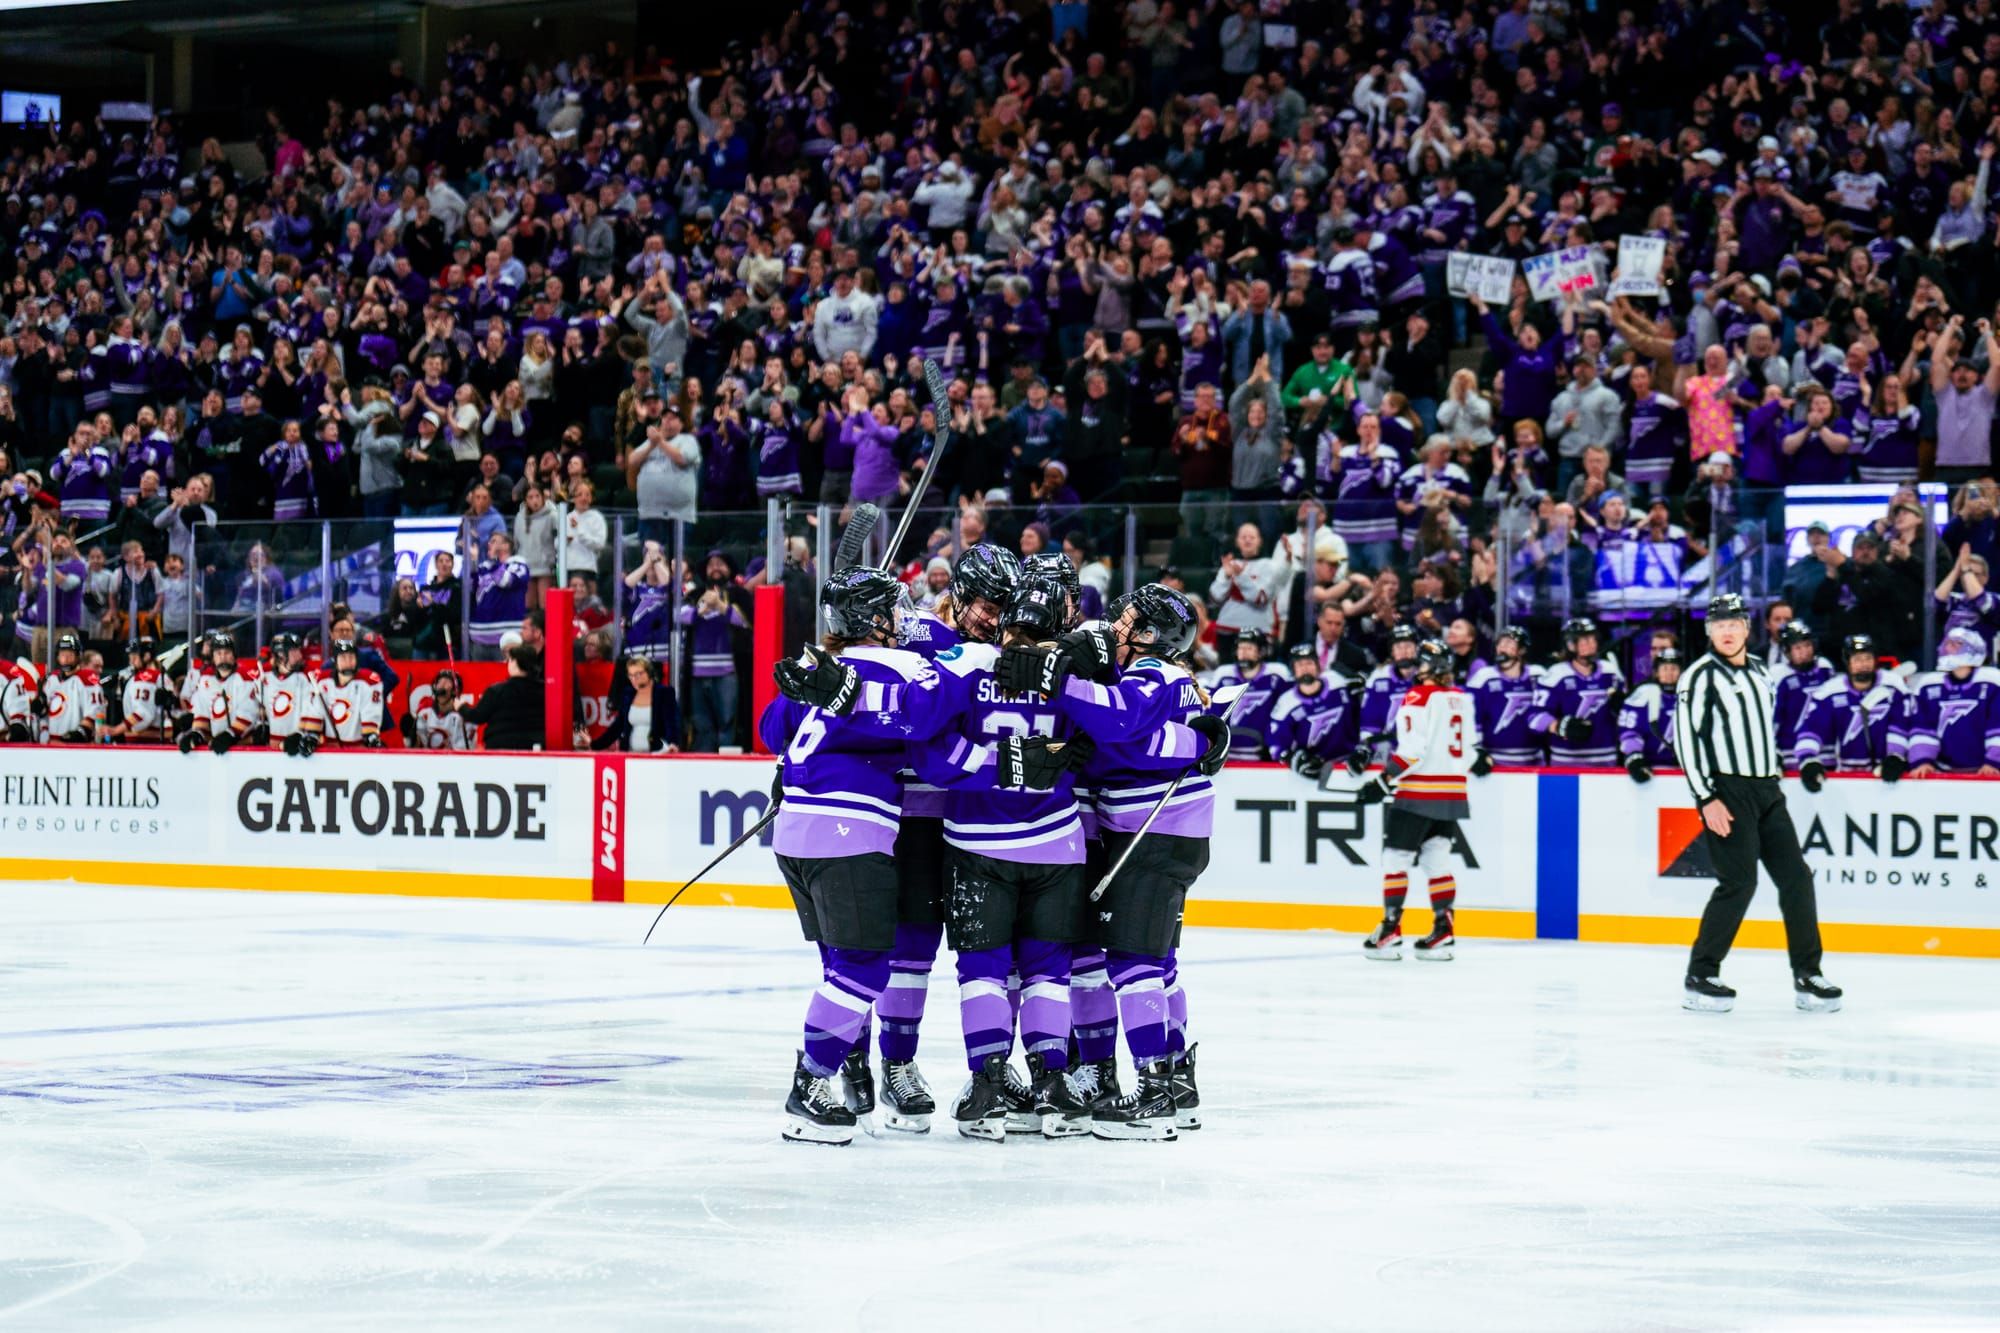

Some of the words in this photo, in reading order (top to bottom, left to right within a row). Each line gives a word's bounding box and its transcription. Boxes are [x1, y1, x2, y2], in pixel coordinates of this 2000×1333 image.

[1029, 590, 1048, 606] 21
[1009, 735, 1024, 786] BAUE
[1448, 714, 1464, 759] 3
[4, 774, 77, 807] FLINT
[86, 776, 160, 810] HILLS
[236, 776, 547, 841] GATORADE
[600, 766, 618, 873] CCM
[1234, 799, 1480, 869] TRA
[1801, 812, 2000, 861] ANDER
